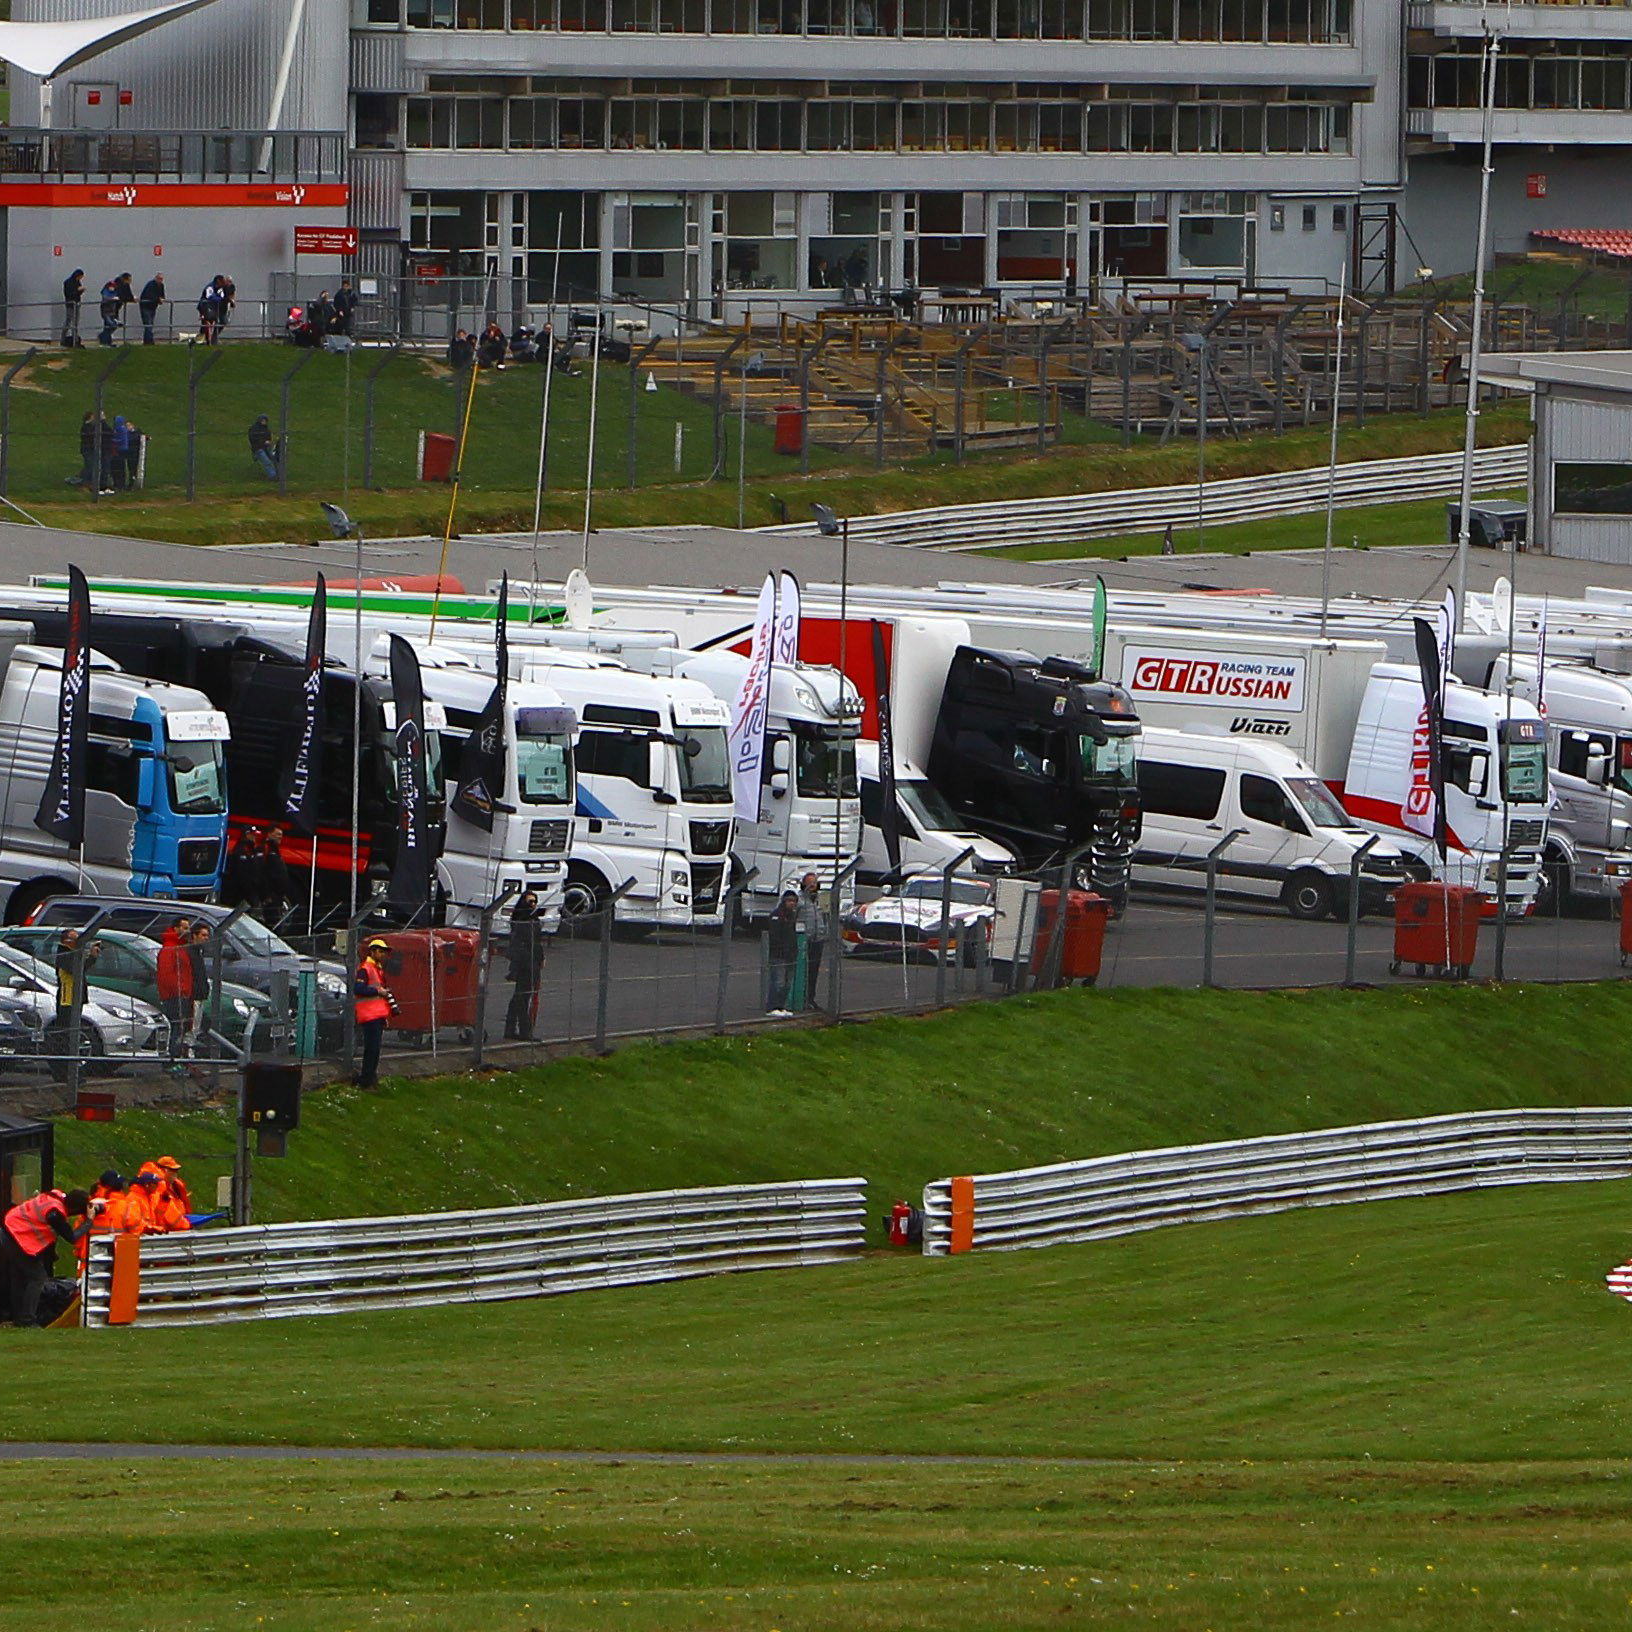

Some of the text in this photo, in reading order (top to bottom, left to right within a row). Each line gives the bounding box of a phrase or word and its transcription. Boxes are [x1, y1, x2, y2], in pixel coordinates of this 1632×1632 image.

[1220, 662, 1296, 677] RACING TEAM
[1229, 716, 1292, 736] Viatti
